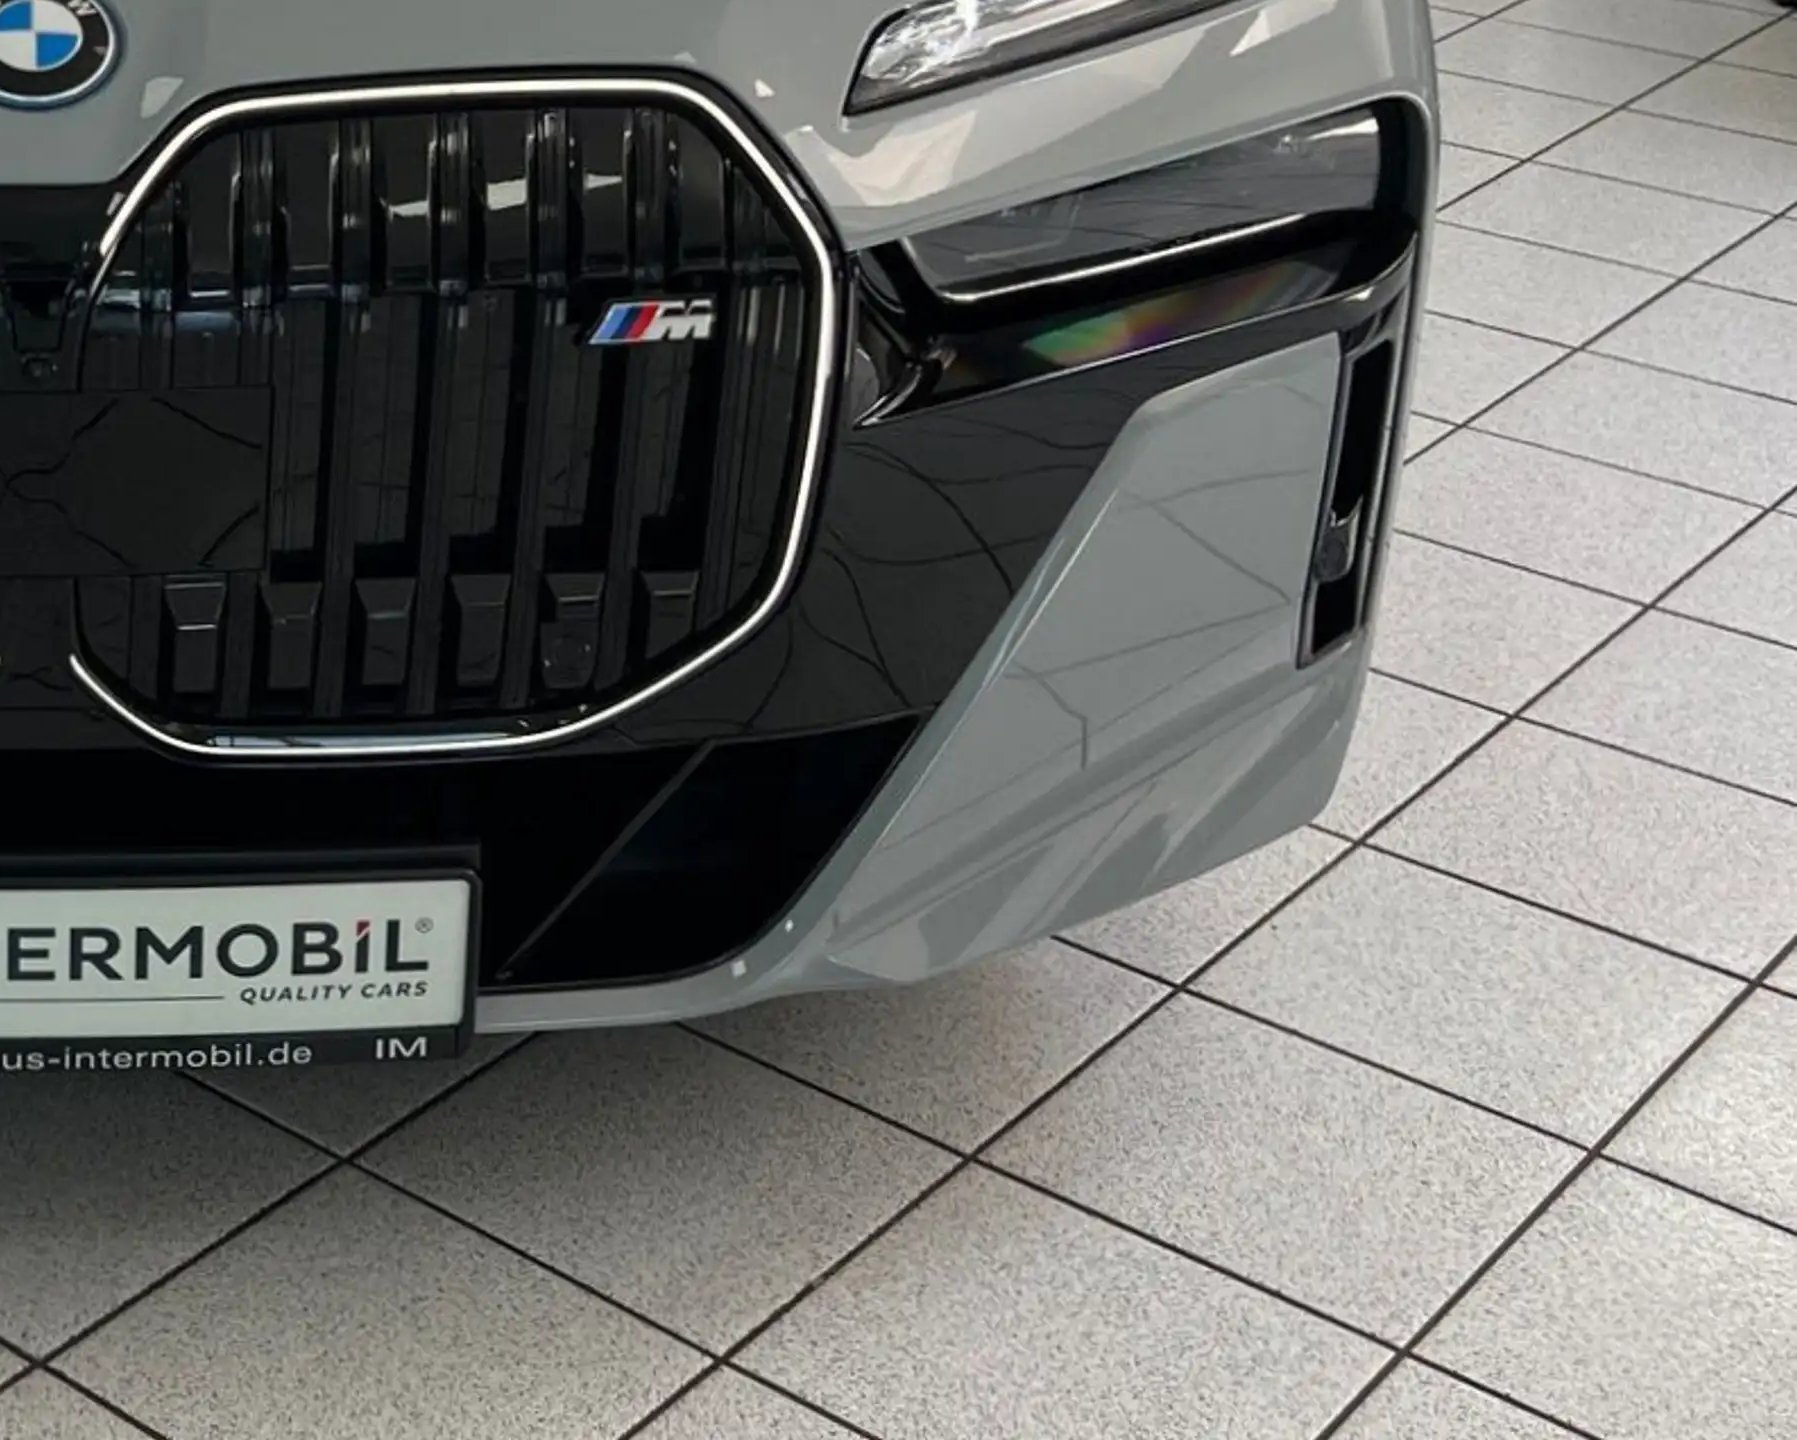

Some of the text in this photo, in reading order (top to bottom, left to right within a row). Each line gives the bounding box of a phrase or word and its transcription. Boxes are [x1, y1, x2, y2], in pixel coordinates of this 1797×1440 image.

[239, 980, 428, 1006] QUALITY CARS
[376, 1037, 427, 1060] IM
